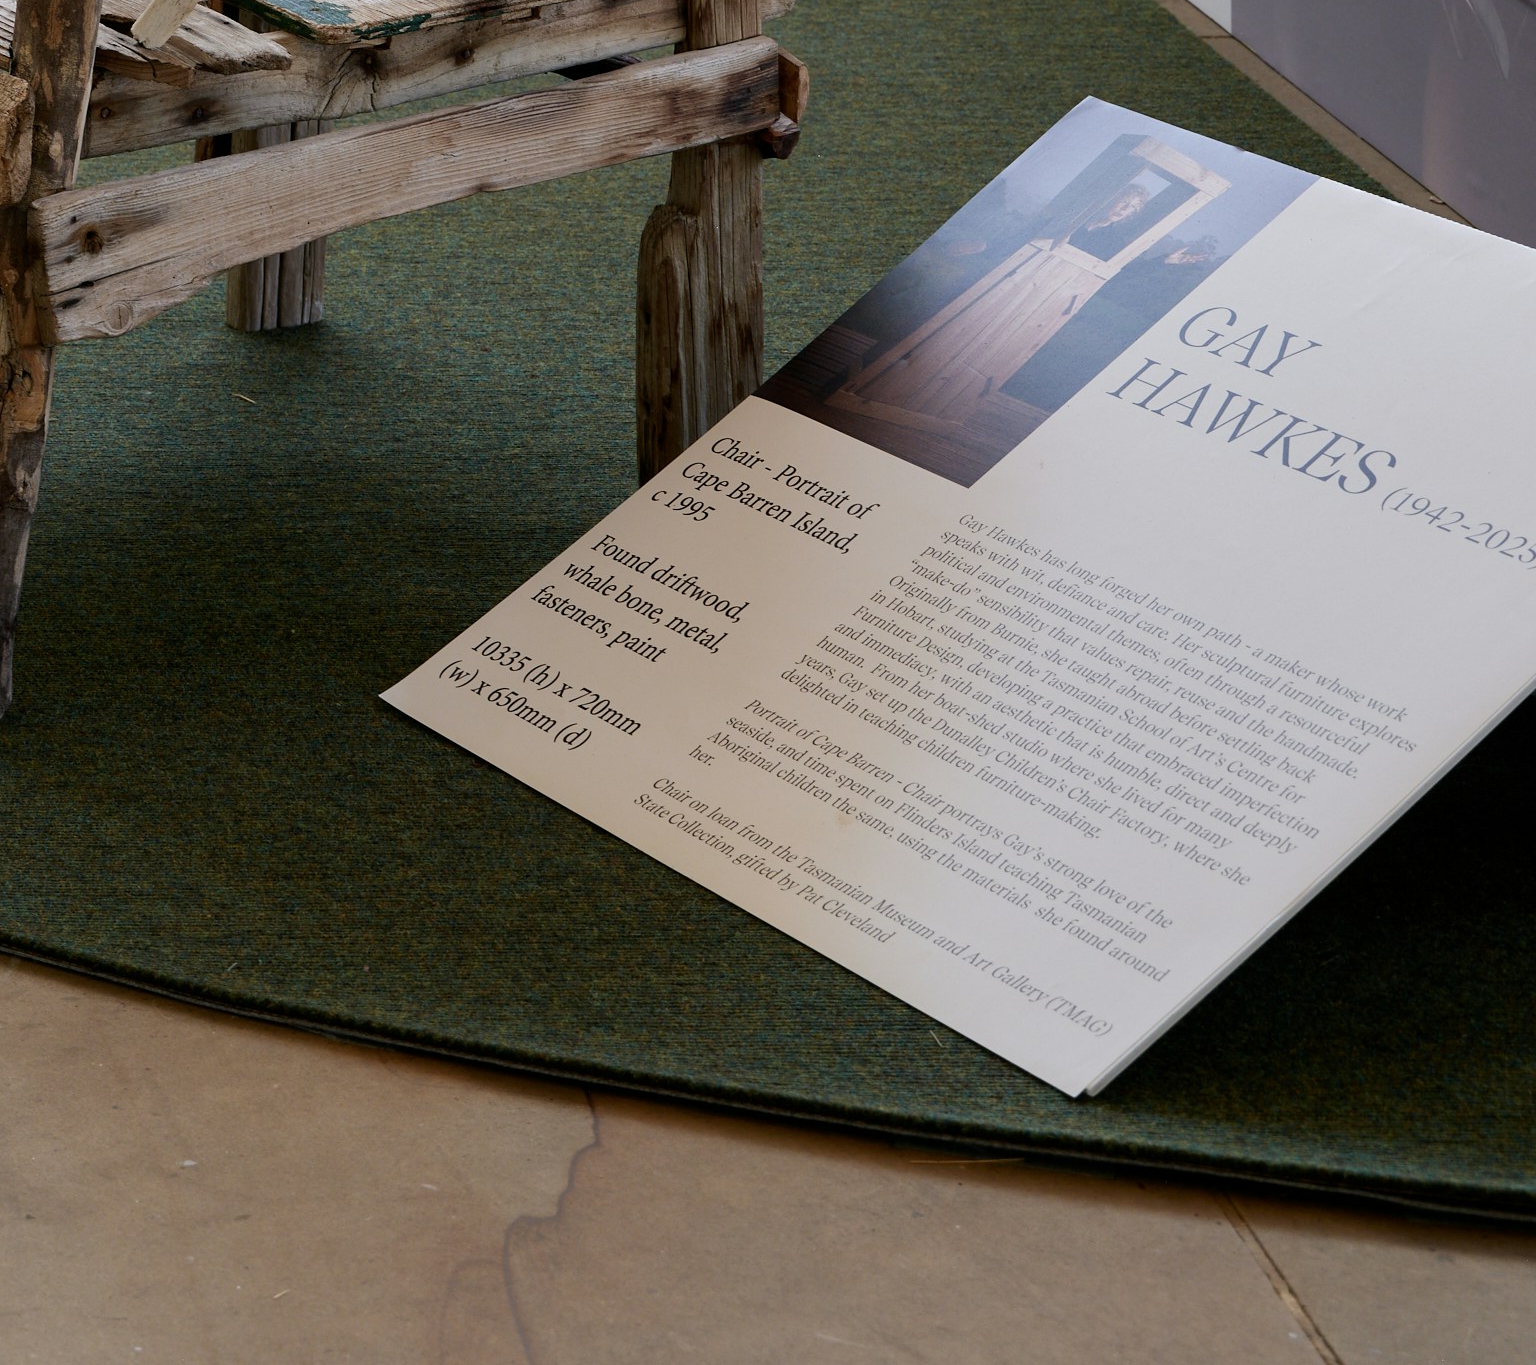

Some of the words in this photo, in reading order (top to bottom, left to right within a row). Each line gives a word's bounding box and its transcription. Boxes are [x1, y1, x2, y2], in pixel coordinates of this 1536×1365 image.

[1179, 307, 1322, 377] GAY
[650, 489, 667, 501] c
[663, 491, 716, 521] 1995
[681, 461, 729, 492] Cape
[725, 480, 792, 523] Barren
[789, 510, 858, 554] Island,
[710, 436, 765, 469] Chair
[771, 463, 850, 509] Portrait
[845, 502, 880, 519] of
[1106, 358, 1396, 494] HAWKES
[1382, 488, 1536, 569] (1942-2025
[530, 584, 612, 639] fasteners,
[605, 630, 667, 662] paint
[562, 562, 617, 596] whale
[613, 583, 664, 624] bone,
[663, 615, 728, 654] metal,
[590, 533, 659, 574] Found
[649, 564, 750, 623] driftwood,
[919, 545, 982, 576] political
[976, 571, 1010, 589] and
[1004, 584, 1111, 635] environmental
[1105, 628, 1161, 663] themes,
[1162, 656, 1204, 681] often
[1203, 673, 1266, 709] through
[1277, 709, 1371, 755] resourceful
[438, 659, 479, 688] (w)
[469, 679, 491, 696] x
[486, 686, 557, 733] 650mm
[552, 722, 592, 751] (d)
[470, 635, 532, 672] 10335
[522, 662, 560, 691] (h)
[551, 682, 573, 698] x
[567, 686, 641, 736] 720mm
[687, 743, 715, 766] her.
[780, 668, 847, 706] delighted
[841, 697, 859, 714] in
[857, 707, 919, 745] teaching
[916, 738, 975, 773] children
[973, 764, 1102, 839] furniture-making.
[815, 634, 865, 669] human.
[869, 662, 909, 689] From
[906, 680, 935, 700] her
[932, 692, 1007, 735] boat-shed
[1000, 730, 1049, 757] studio
[1048, 752, 1095, 781] where
[1093, 775, 1122, 794] she
[1120, 785, 1164, 814] lived
[1158, 805, 1187, 825] for
[1183, 820, 1233, 850] many
[833, 622, 866, 641] and
[859, 632, 938, 681] immediacy,
[939, 673, 973, 695] with
[970, 690, 992, 705] an
[990, 700, 1058, 736] aesthetic
[1055, 729, 1089, 752] that
[1086, 743, 1104, 759] is
[1101, 750, 1162, 791] humble,
[1164, 782, 1211, 812] direct
[1208, 807, 1247, 828] and
[1241, 821, 1297, 854] deeply
[851, 604, 917, 643] Furniture
[914, 635, 964, 669] Design,
[965, 660, 1044, 706] developing
[1048, 704, 1113, 738] practice
[1111, 731, 1146, 754] that
[1144, 749, 1224, 790] embraced
[1217, 781, 1319, 839] imperfection
[869, 588, 887, 605] in
[884, 596, 936, 631] Hobart,
[936, 623, 1000, 660] studying
[996, 652, 1016, 666] at
[1013, 659, 1040, 677] the
[1039, 669, 1119, 716] Tasmanian
[1118, 708, 1173, 740] School
[1168, 734, 1194, 748] of
[1225, 759, 1279, 792] Centre
[1277, 783, 1306, 804] for
[888, 574, 958, 614] Originally
[953, 605, 991, 630] from
[989, 622, 1039, 655] Burnie,
[1040, 648, 1068, 666] she
[1066, 659, 1117, 689] taught
[1115, 684, 1173, 714] abroad
[1168, 705, 1218, 737] before
[1216, 732, 1278, 767] settling
[1275, 756, 1316, 784] back
[975, 594, 1050, 633] sensibility
[1046, 625, 1080, 647] that
[1080, 641, 1126, 668] values
[1123, 663, 1173, 693] repair,
[1172, 685, 1216, 710] reuse
[1213, 705, 1251, 725] and
[1245, 718, 1274, 738] the
[1272, 728, 1358, 779] handmade.
[706, 731, 782, 773] Aboriginal
[775, 768, 832, 803] children
[830, 796, 857, 815] the
[854, 810, 894, 838] same,
[895, 831, 939, 860] using
[935, 852, 963, 872] the
[960, 867, 1032, 909] materials
[1033, 906, 1063, 926] she
[1061, 918, 1114, 951] found
[1107, 946, 1171, 982] around
[725, 716, 775, 749] seaside,
[775, 742, 809, 762] and
[802, 755, 837, 778] time
[834, 773, 875, 799] spent
[873, 794, 894, 810] on
[892, 801, 953, 840] Flinders
[950, 832, 1003, 865] Island
[997, 858, 1064, 900] teaching
[1062, 889, 1147, 944] Tasmanian
[794, 653, 836, 680] years,
[837, 671, 868, 693] Gay
[864, 687, 889, 703] set
[886, 697, 908, 714] up
[906, 706, 932, 725] the
[930, 717, 996, 757] Dunalley
[1066, 786, 1112, 814] Chair
[1107, 806, 1170, 847] Factory,
[1172, 840, 1222, 871] where
[1219, 865, 1251, 886] she
[633, 793, 671, 818] State
[667, 812, 735, 858] Collection,
[731, 852, 784, 880] gifted
[776, 872, 800, 891] by
[795, 884, 824, 905] Pat
[821, 898, 897, 943] Cleveland
[652, 777, 693, 803] Chair
[687, 799, 709, 814] on
[705, 806, 739, 831] loan
[736, 823, 774, 850] from
[771, 844, 798, 863] the
[795, 855, 873, 905] Tasmanian
[870, 898, 935, 939] Museum
[932, 935, 971, 956] and
[961, 951, 993, 972] Art
[989, 965, 1050, 1005] Gallery
[1044, 995, 1113, 1037] (TMAG)
